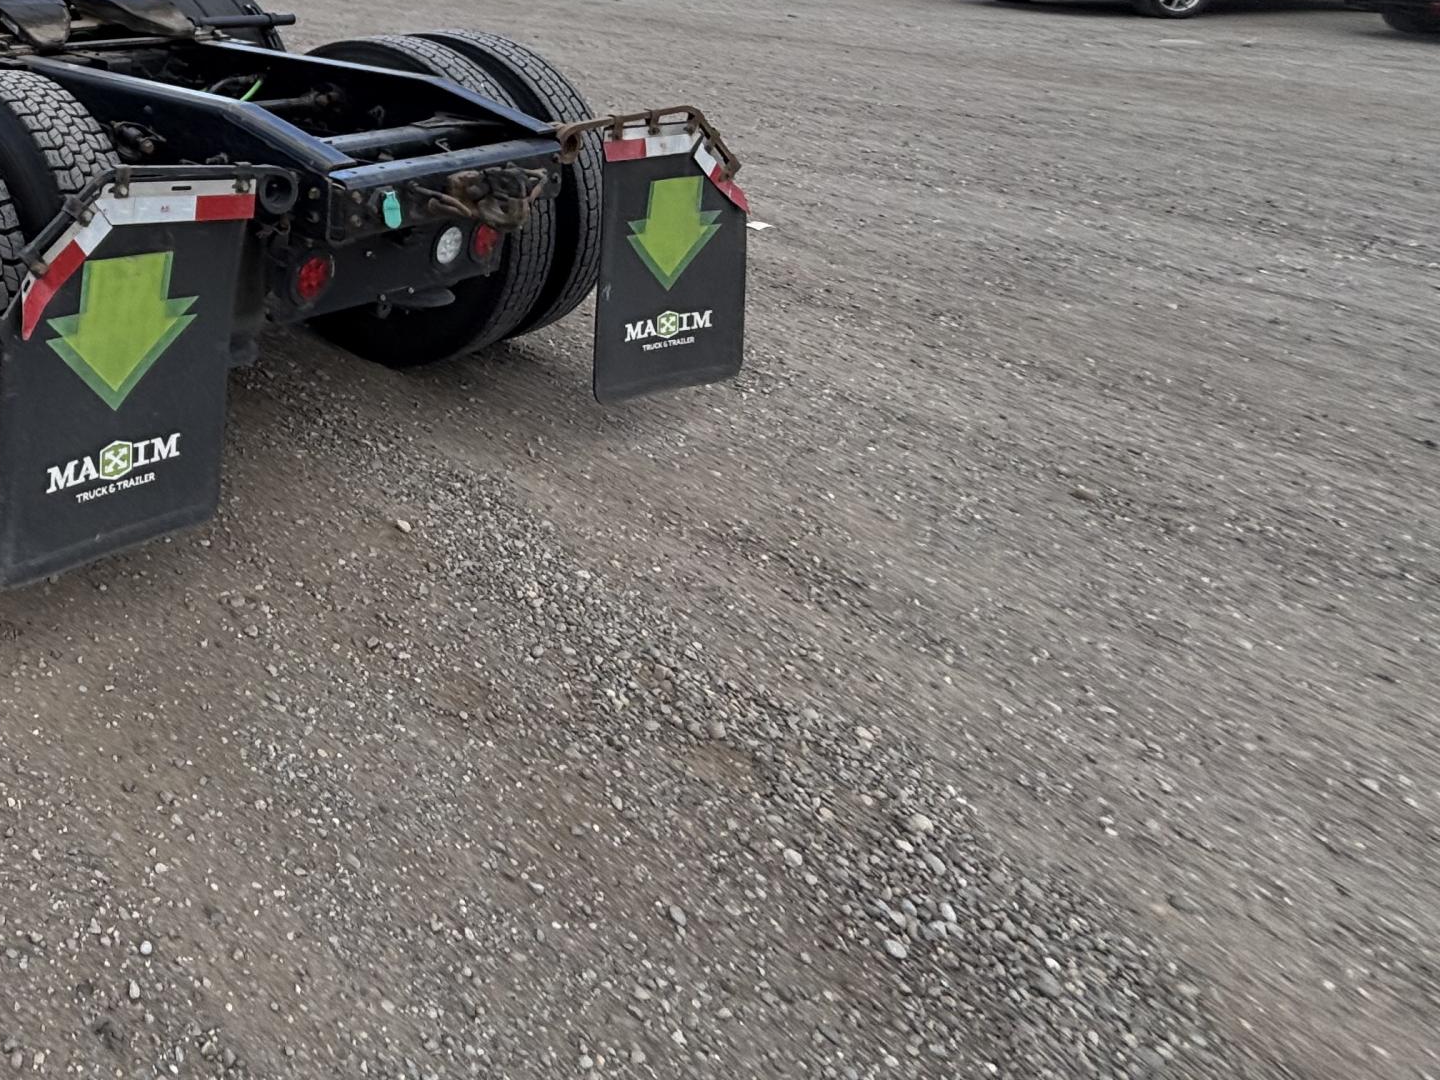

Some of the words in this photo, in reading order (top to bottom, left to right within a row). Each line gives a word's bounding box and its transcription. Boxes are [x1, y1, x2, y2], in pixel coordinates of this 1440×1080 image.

[624, 309, 713, 342] MAXIM
[642, 342, 663, 351] TRUCK
[668, 336, 695, 347] TRAILER
[46, 432, 181, 494] MAXIM
[76, 485, 109, 504] TRUCK
[108, 483, 116, 494] &
[116, 472, 156, 491] TRAILER
